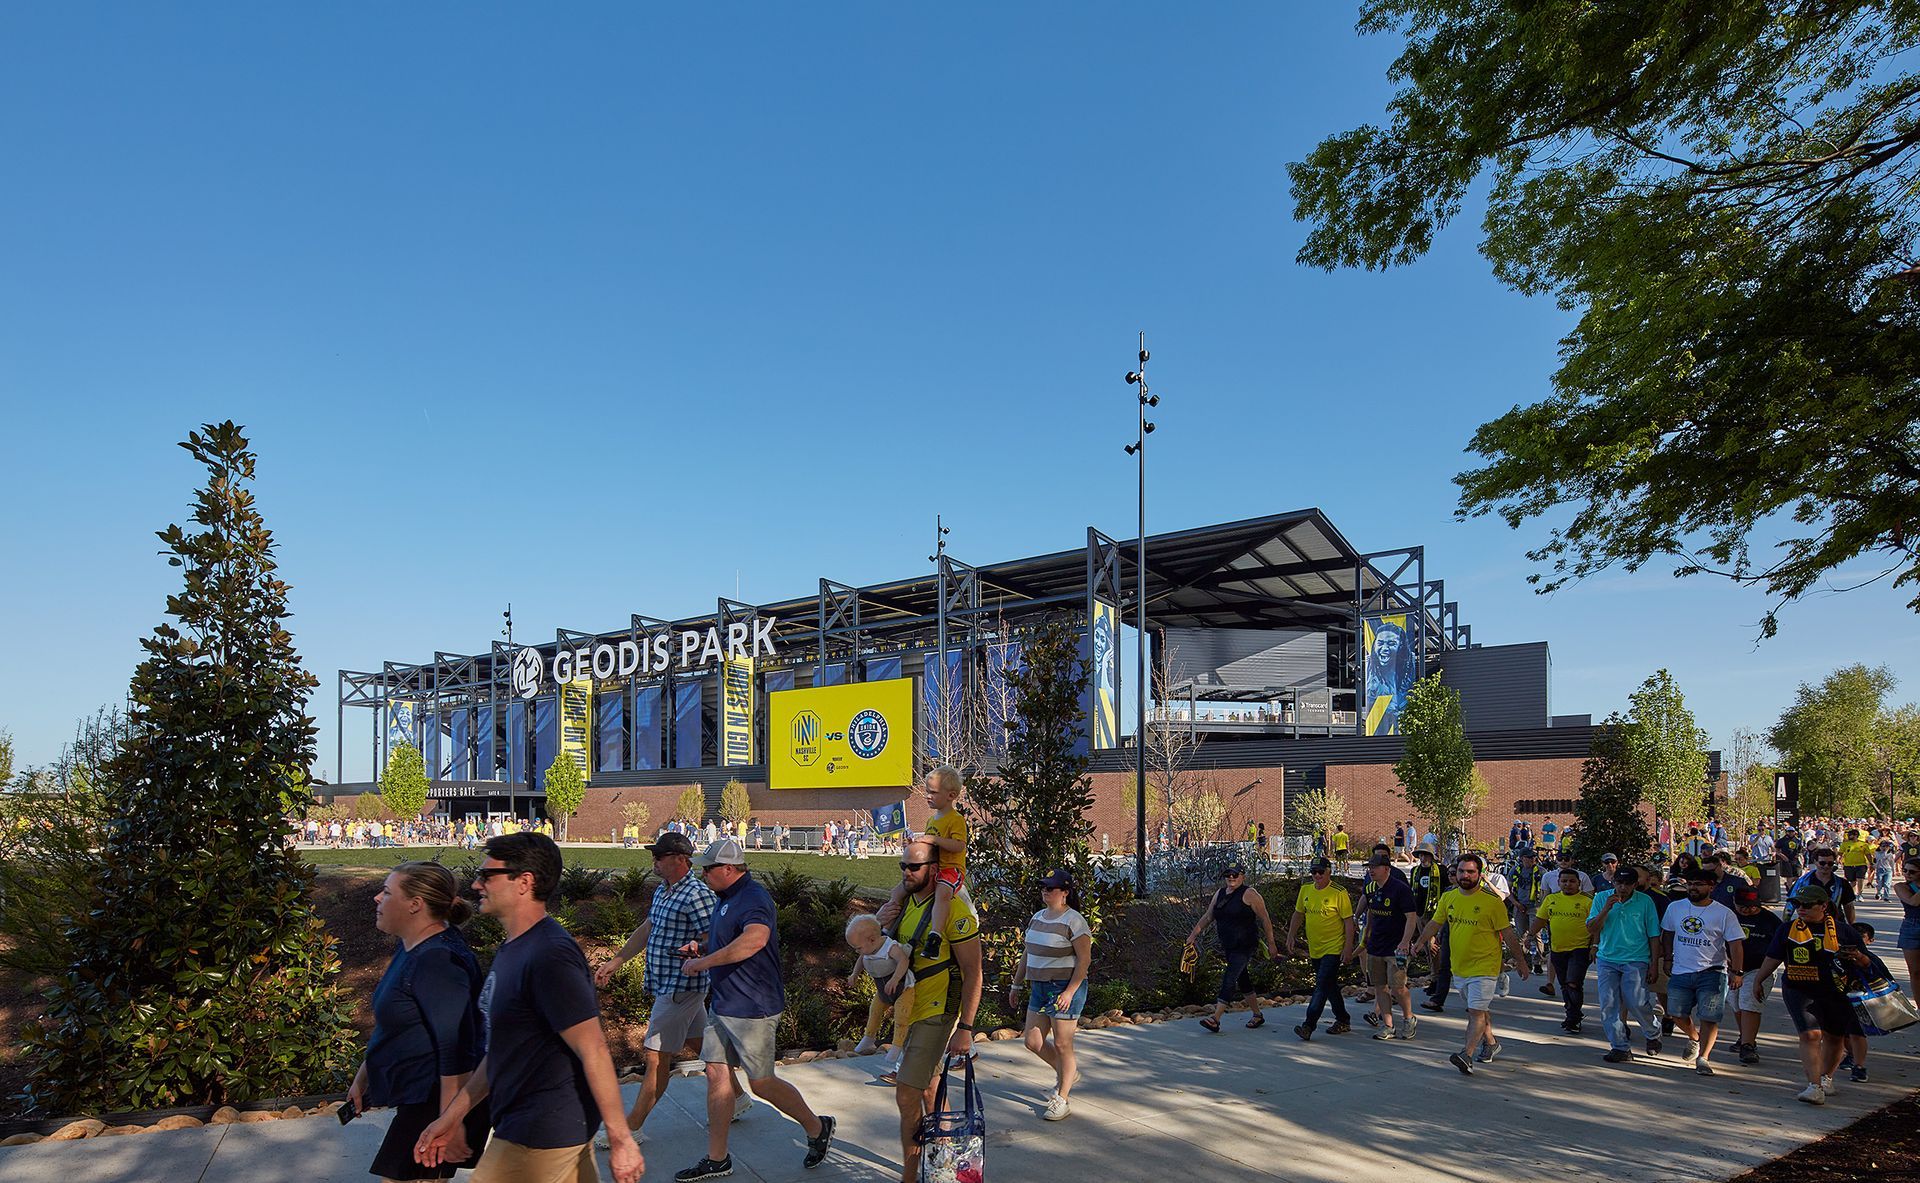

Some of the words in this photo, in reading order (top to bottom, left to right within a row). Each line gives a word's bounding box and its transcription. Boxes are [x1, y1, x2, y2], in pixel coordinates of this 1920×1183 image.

[552, 634, 670, 685] GEODIS
[682, 616, 777, 668] PARK
[727, 667, 748, 708] BOYS
[564, 689, 587, 723] COME
[727, 711, 748, 727] IN
[850, 711, 887, 733] PHILADELPHIA
[564, 726, 586, 744] ON
[795, 746, 817, 755] NASHVILLE
[460, 786, 475, 797] GATE
[1776, 776, 1787, 798] A
